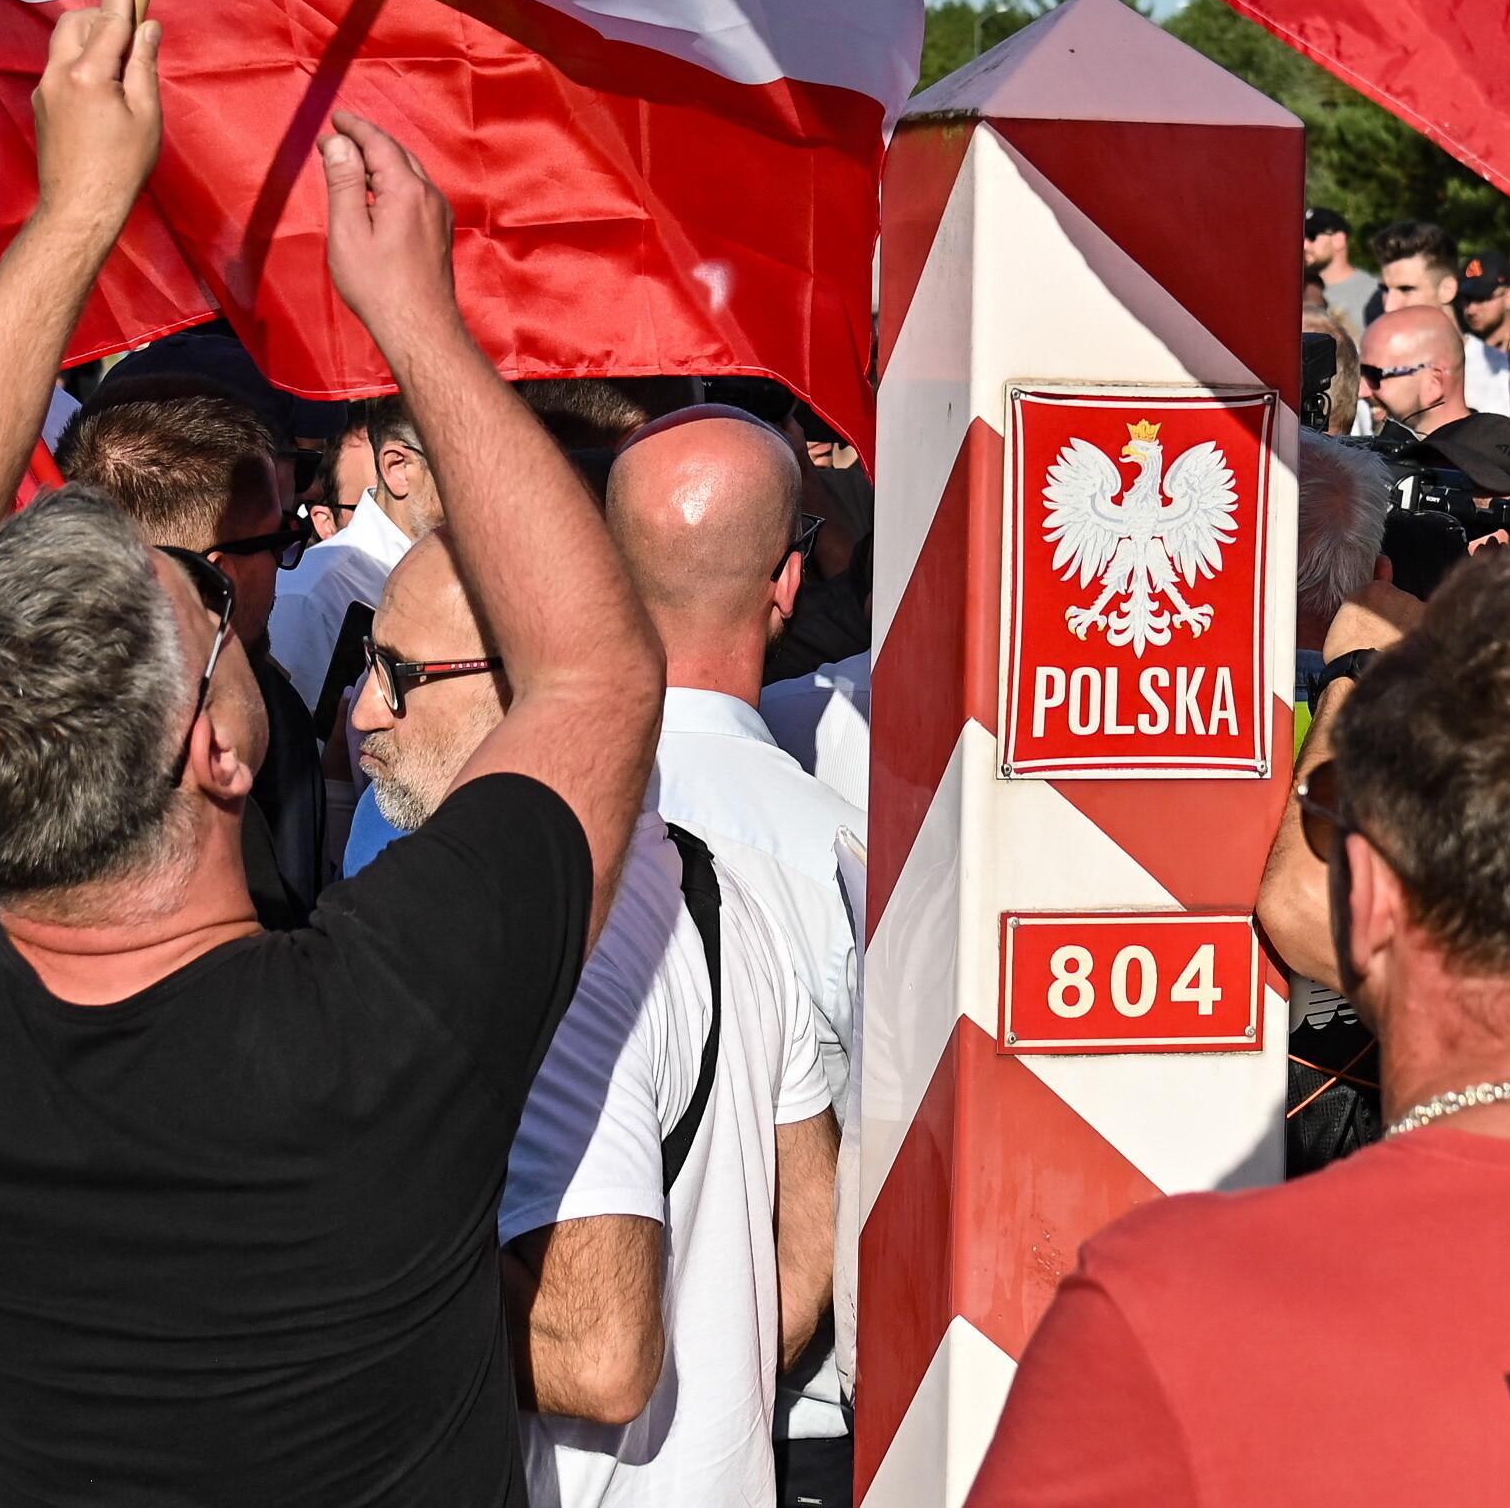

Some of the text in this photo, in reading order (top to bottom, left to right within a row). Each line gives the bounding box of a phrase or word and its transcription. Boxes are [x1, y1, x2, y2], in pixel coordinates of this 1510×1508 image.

[450, 660, 486, 670] PRADA
[1032, 666, 1240, 738] POLSKA
[1047, 943, 1223, 1019] 804
